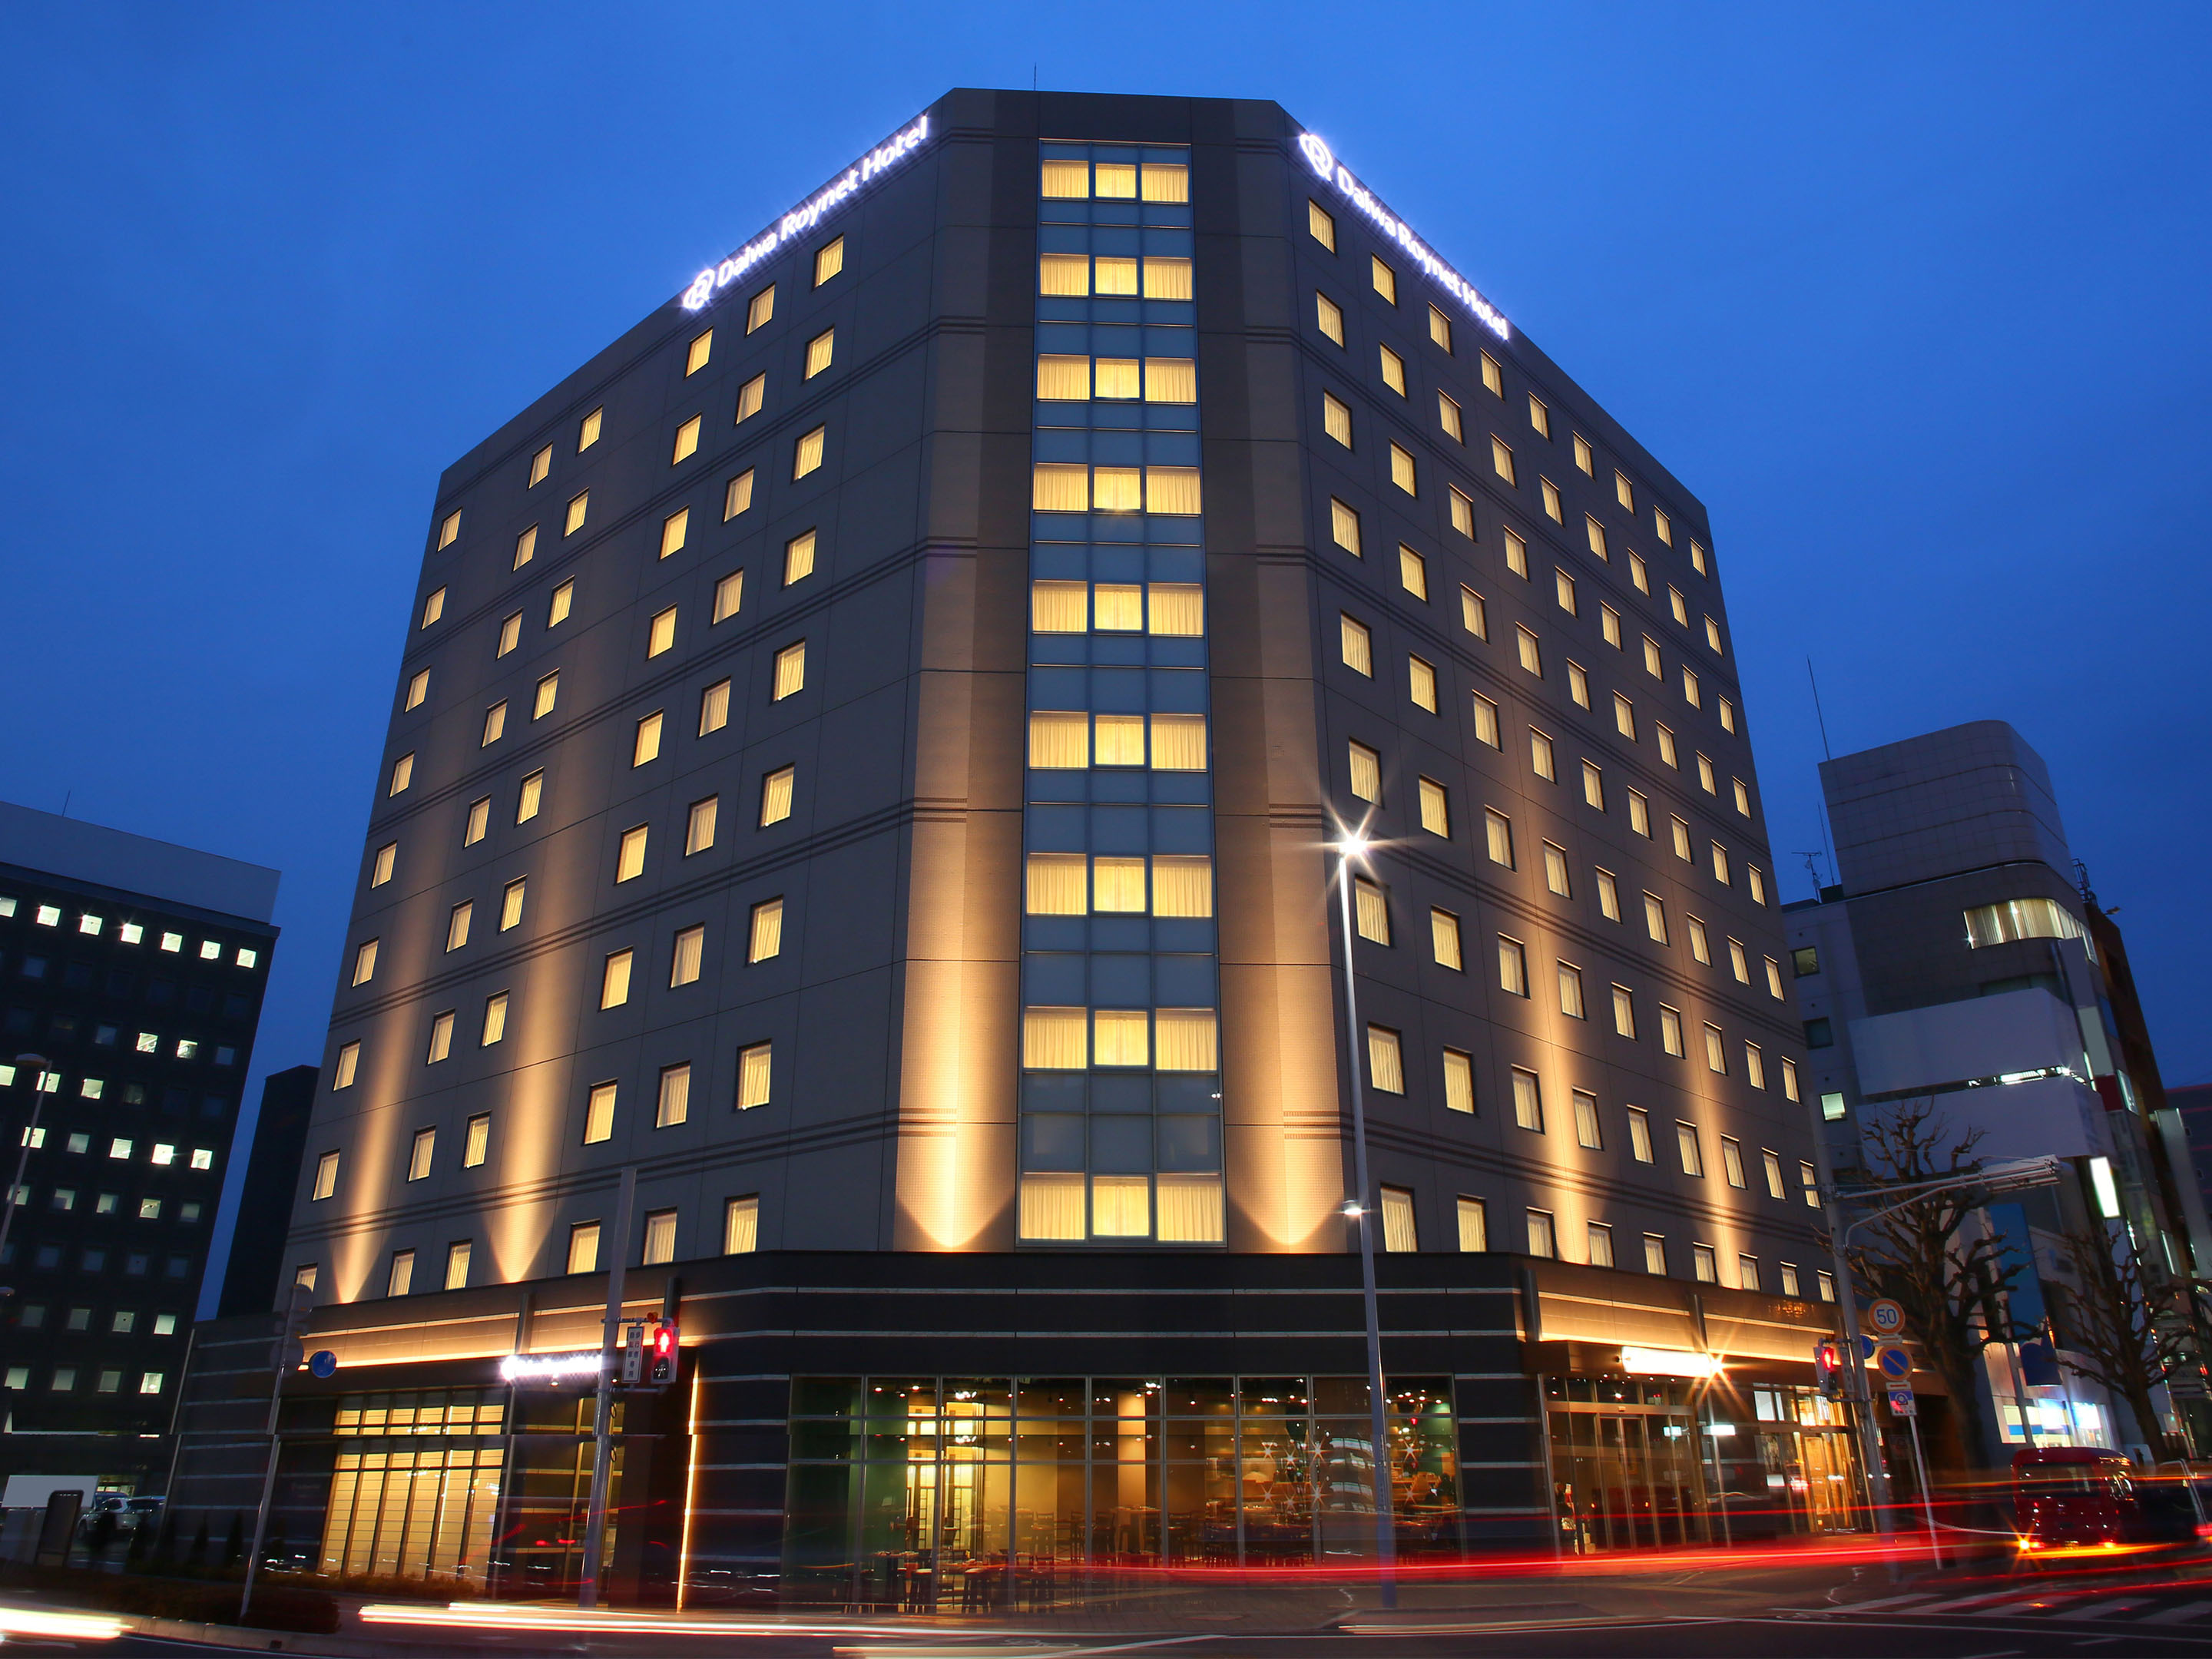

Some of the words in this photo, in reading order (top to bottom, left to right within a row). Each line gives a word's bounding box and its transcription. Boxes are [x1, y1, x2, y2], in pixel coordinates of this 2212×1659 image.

[717, 233, 777, 287] Daiwa
[780, 169, 859, 240] Roynet
[862, 114, 928, 180] Hotel
[1337, 167, 1396, 237] Daiwa
[1397, 222, 1462, 297] Roynet
[1462, 283, 1508, 339] Hotel
[1876, 1309, 1897, 1324] 50
